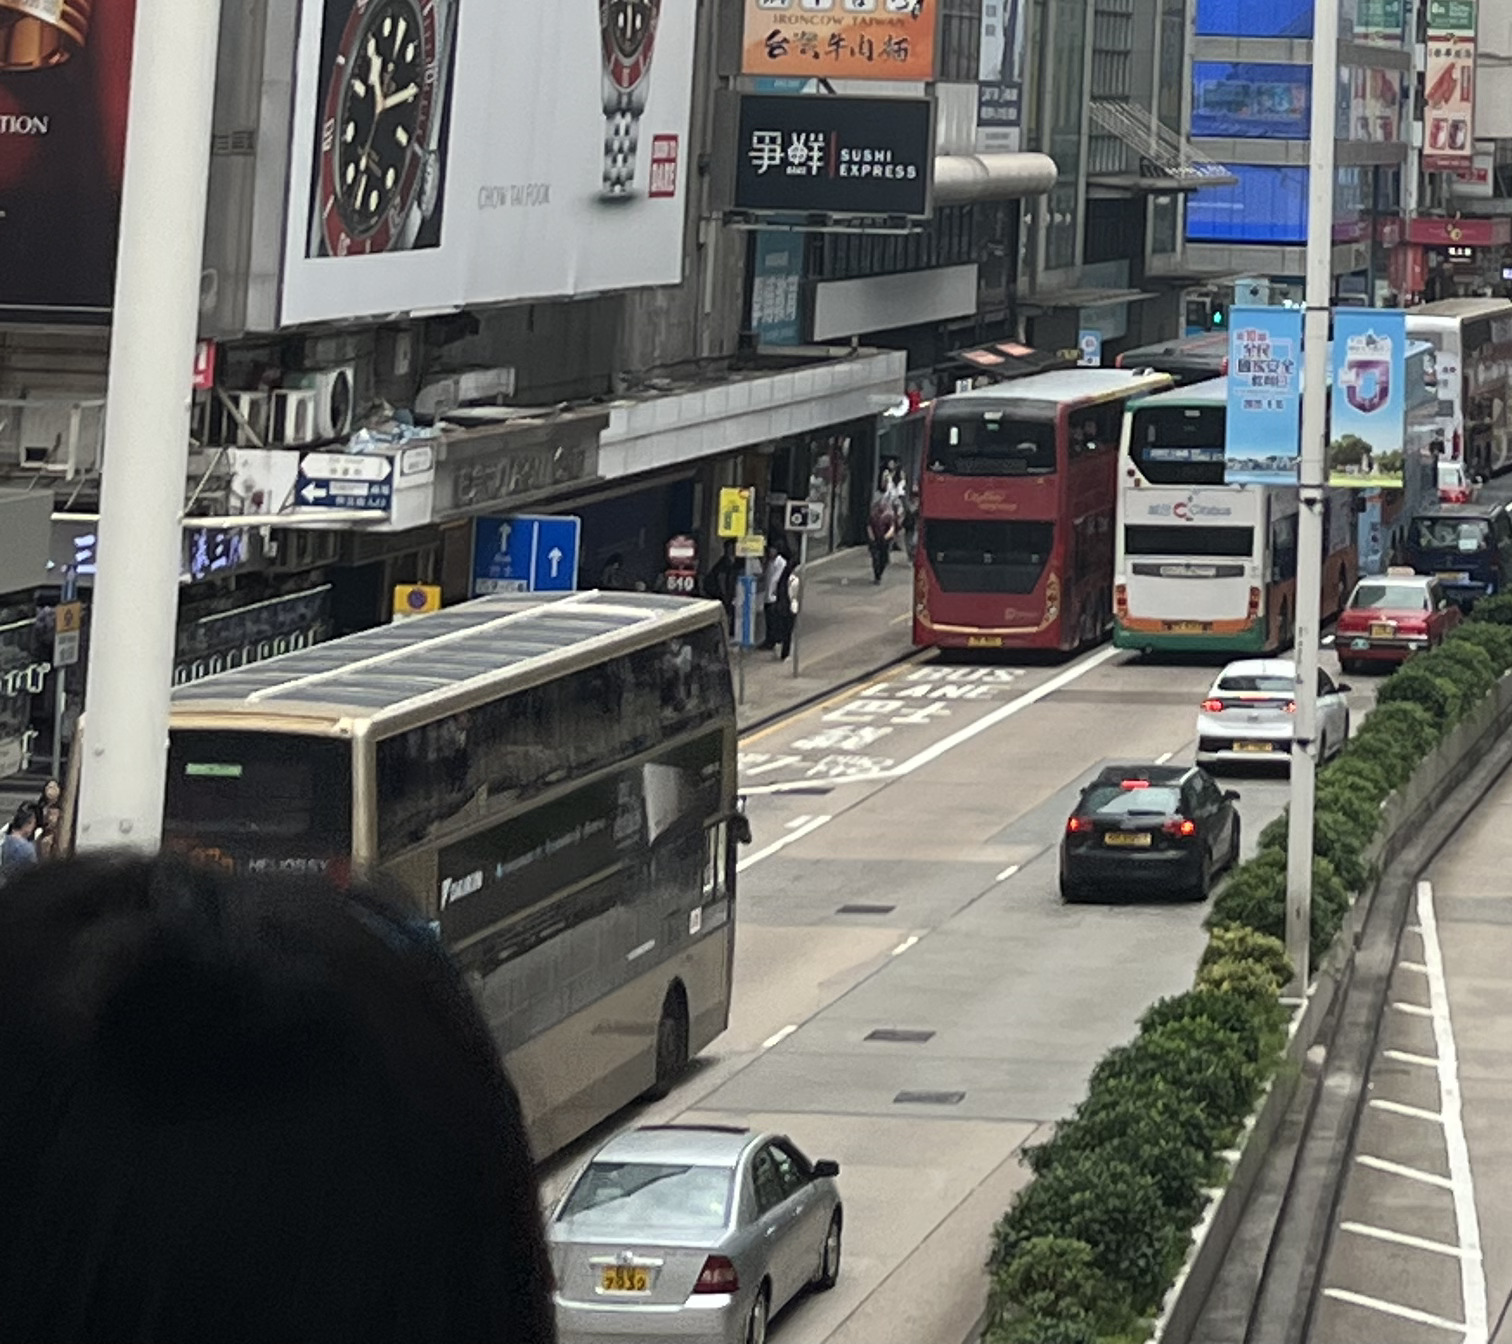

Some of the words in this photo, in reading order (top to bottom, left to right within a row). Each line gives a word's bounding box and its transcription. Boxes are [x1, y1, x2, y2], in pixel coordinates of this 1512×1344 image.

[773, 14, 844, 26] IRONCOW
[748, 131, 825, 175] 爭鮮
[841, 149, 892, 162] SUSHI
[840, 164, 917, 179] EXPRESS
[906, 667, 1027, 682] BUS
[860, 683, 1011, 699] LANE
